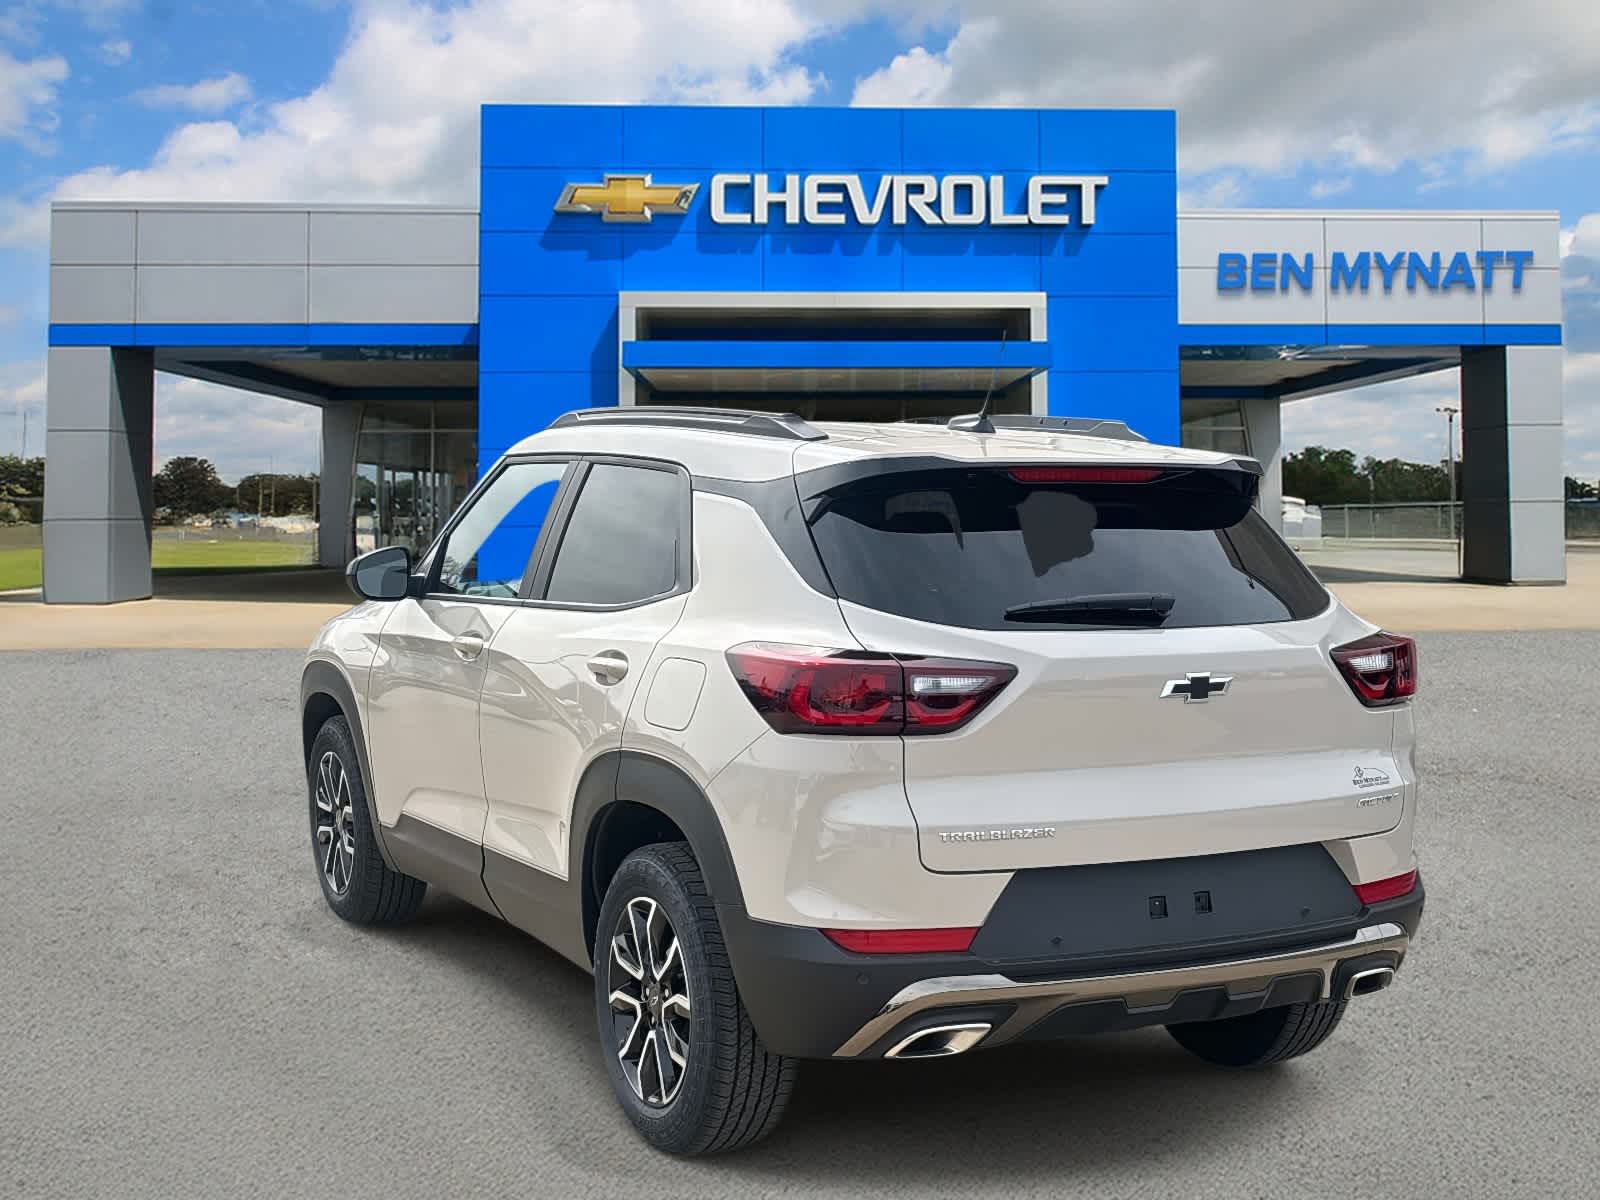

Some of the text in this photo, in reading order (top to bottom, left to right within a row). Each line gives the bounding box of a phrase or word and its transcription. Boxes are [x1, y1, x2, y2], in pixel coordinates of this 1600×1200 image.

[710, 173, 1109, 226] CHEVROLET
[1217, 249, 1535, 292] BEN MYNATT
[938, 826, 1056, 843] TRAILBLAZER
